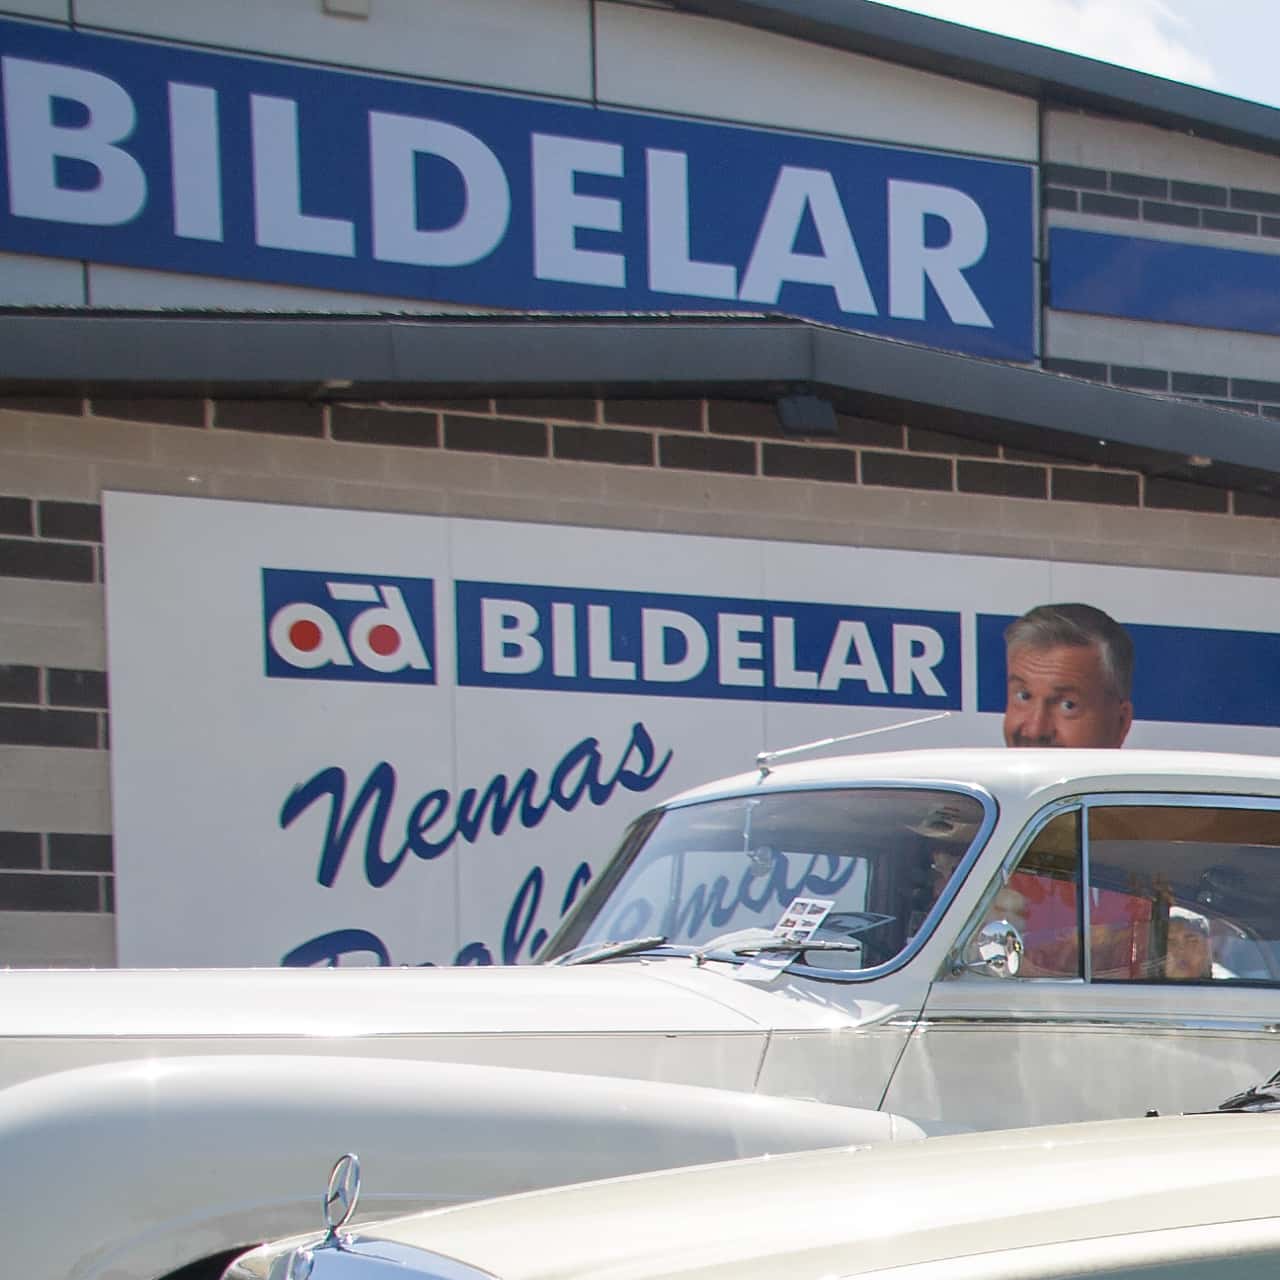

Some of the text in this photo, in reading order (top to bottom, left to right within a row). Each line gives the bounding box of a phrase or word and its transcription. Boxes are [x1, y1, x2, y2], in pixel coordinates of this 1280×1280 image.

[2, 55, 994, 329] BILDELAR
[269, 581, 948, 697] ad BILDELAR
[280, 721, 674, 889] Nemas
